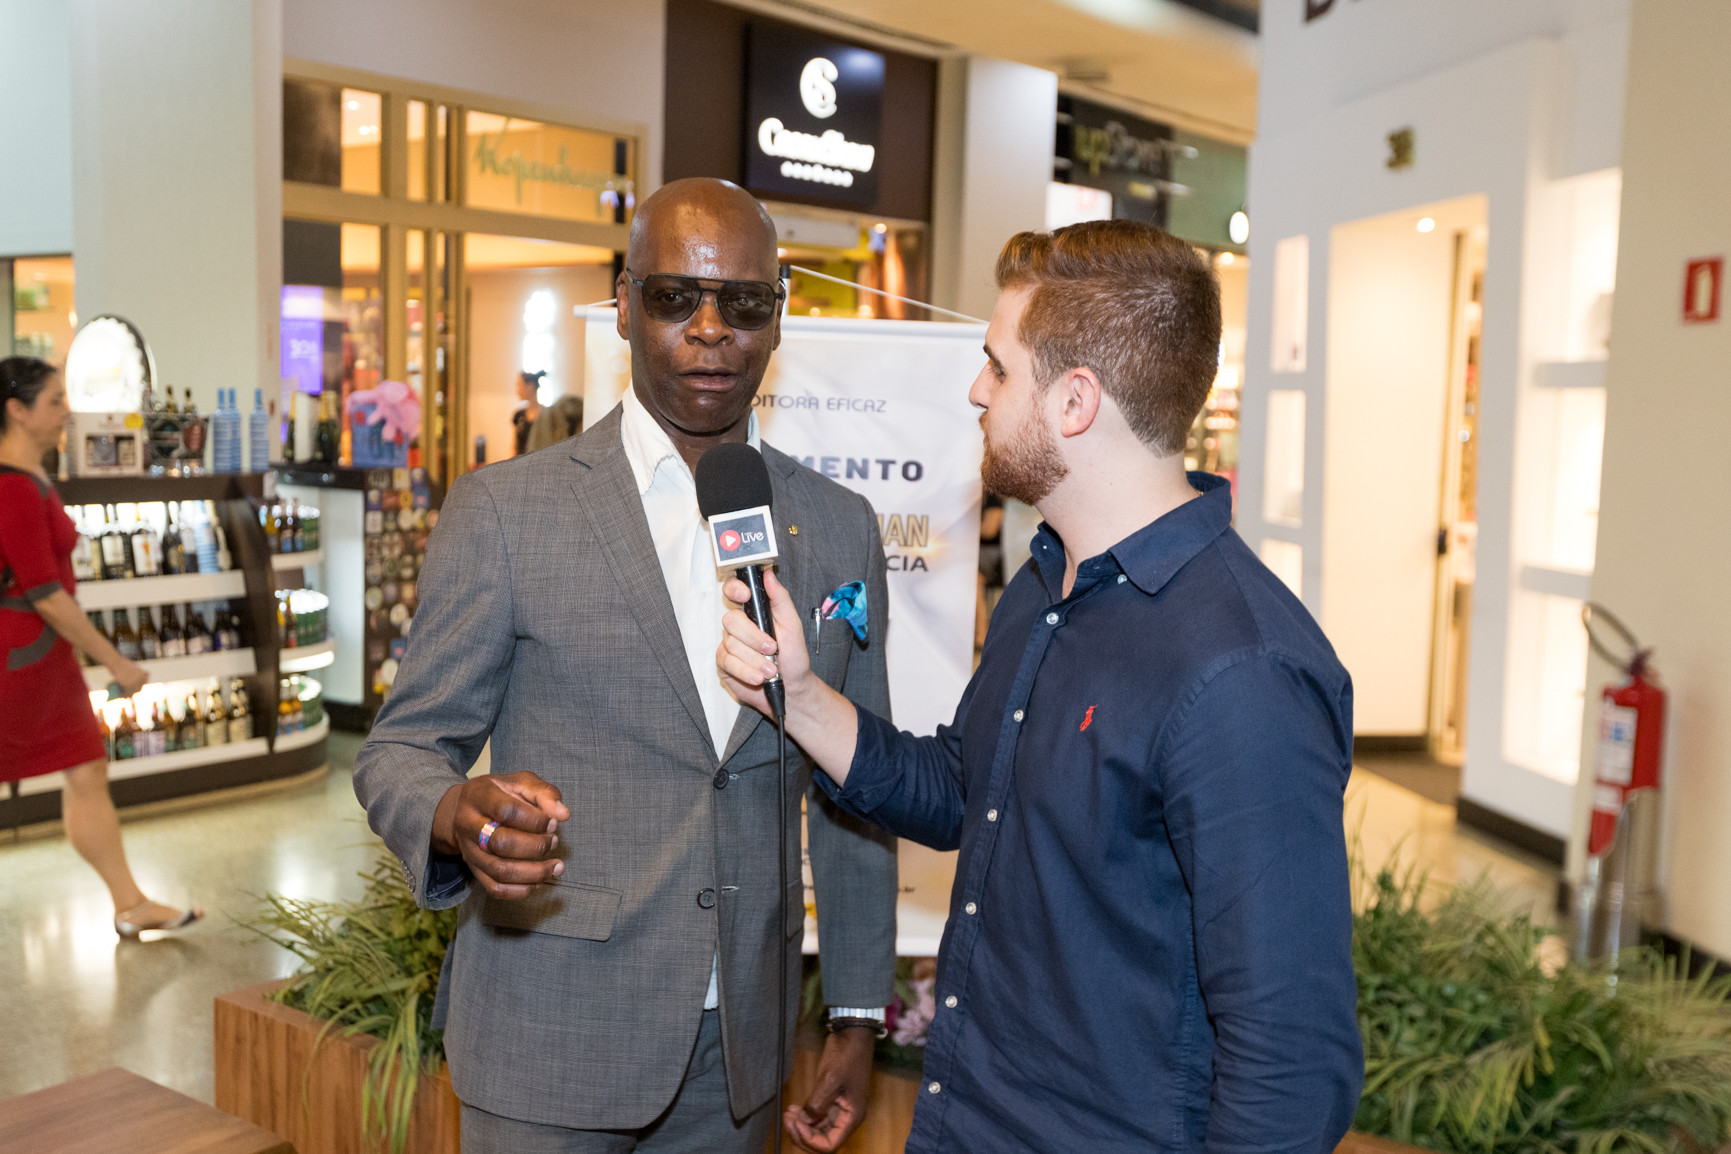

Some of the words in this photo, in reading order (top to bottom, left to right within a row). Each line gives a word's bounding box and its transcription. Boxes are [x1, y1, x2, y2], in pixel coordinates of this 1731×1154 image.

[752, 394, 819, 410] DITORA
[826, 397, 887, 413] EFICAZ
[741, 531, 765, 544] Live
[886, 555, 930, 573] CIA
